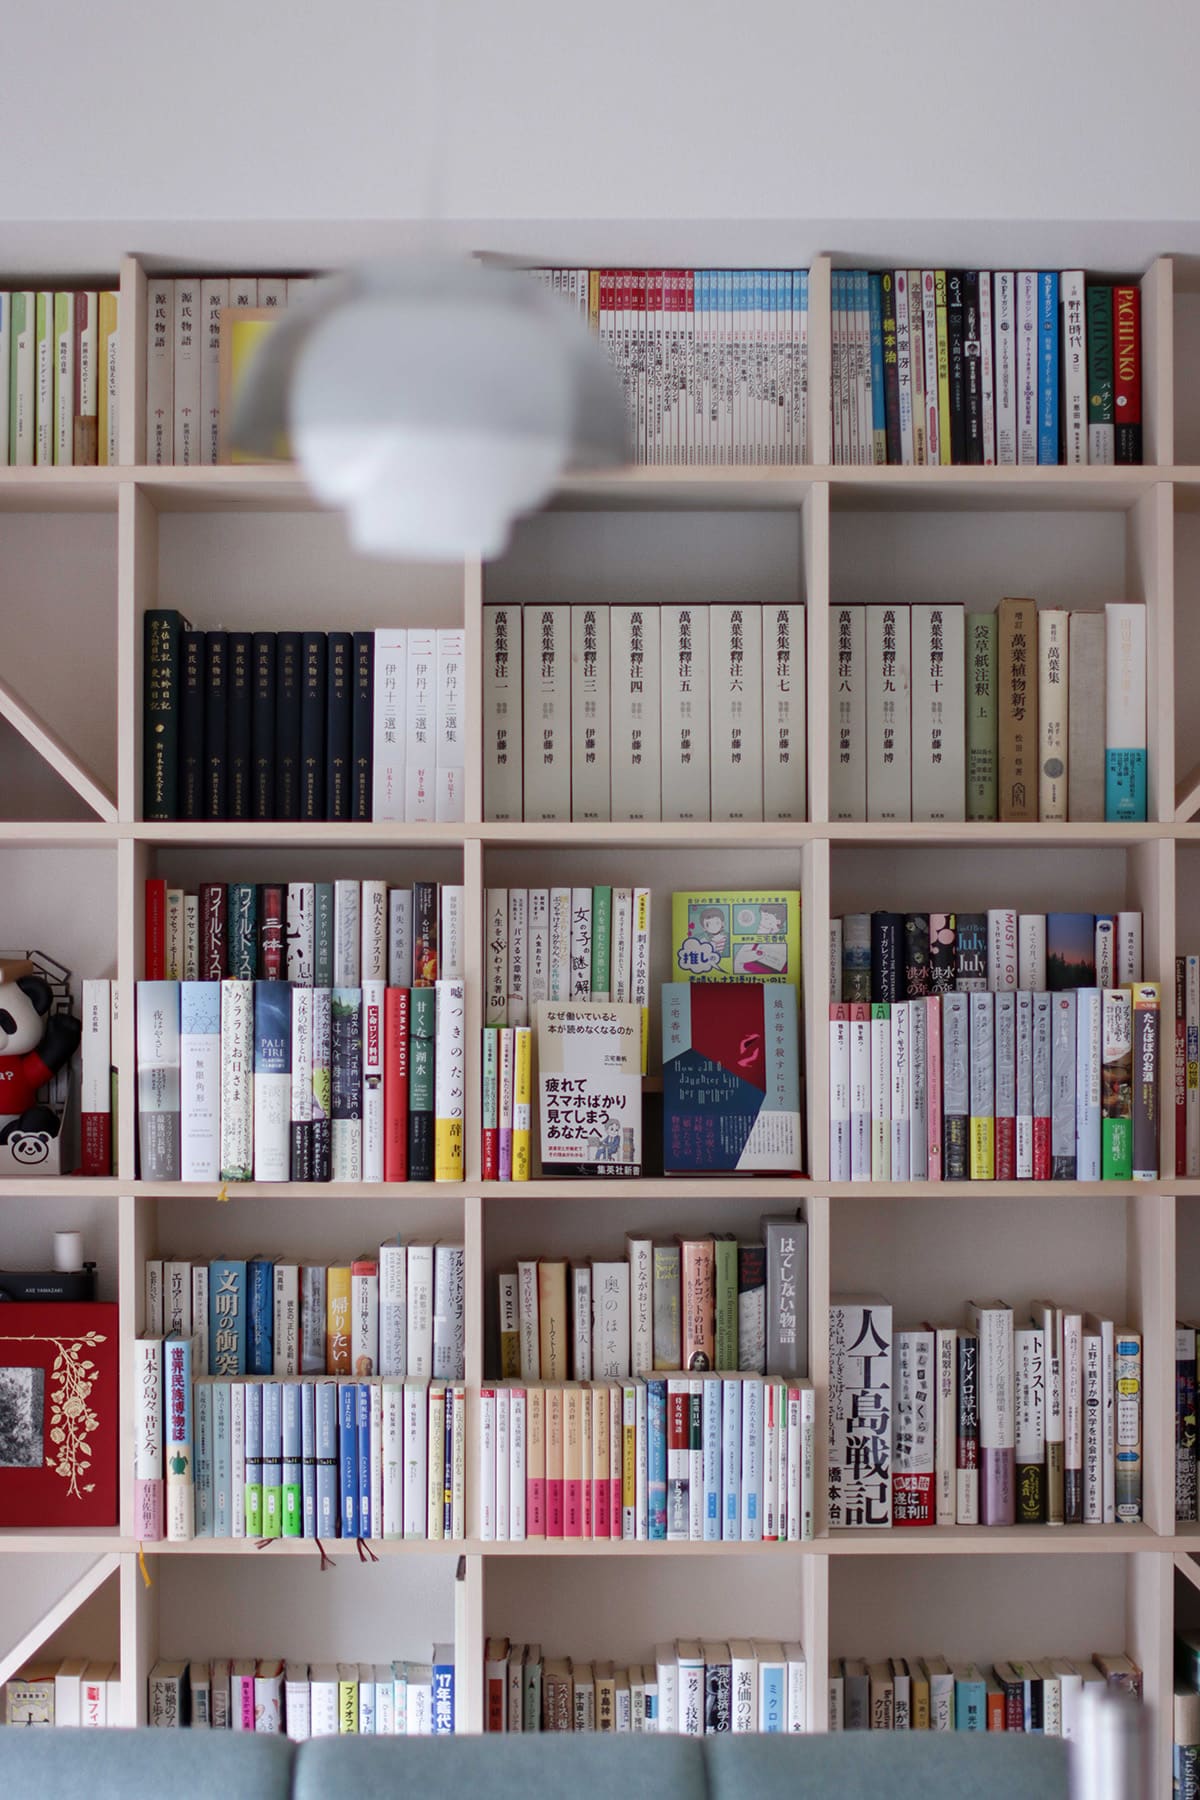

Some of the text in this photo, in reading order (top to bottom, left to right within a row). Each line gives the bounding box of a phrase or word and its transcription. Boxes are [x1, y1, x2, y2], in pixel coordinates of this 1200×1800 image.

[154, 293, 166, 348] 源氏物語
[181, 292, 192, 347] 源氏物語
[209, 296, 221, 349] 源氏物語
[884, 318, 897, 364] 橋本治
[1068, 300, 1081, 348] 野性時代
[1118, 289, 1135, 380] PACHINKO
[897, 324, 910, 387] 氷室冴子
[1101, 381, 1111, 421] パチンコ
[187, 644, 197, 687] 源氏物語
[212, 644, 221, 687] 源氏物語
[259, 644, 268, 687] 源氏物語
[309, 644, 318, 687] 源氏物語
[334, 644, 343, 687] 源氏物語
[359, 644, 368, 687] 源氏物語
[495, 611, 508, 689] 萬葉集釋注一
[542, 611, 555, 693] 萬葉集釋注二
[584, 610, 597, 693] 萬葉集釋注三
[631, 611, 643, 694] 萬葉集釋注四
[679, 610, 692, 693] 萬葉集釋注五
[730, 609, 743, 693] 萬葉集釋注六
[777, 609, 790, 693] 萬葉集釋注七
[839, 610, 852, 693] 萬葉集釋注八
[883, 610, 896, 693] 萬葉集釋注九
[930, 610, 943, 694] 萬葉集釋注十
[975, 624, 990, 719] 袋草紙注釈 上
[1010, 632, 1027, 721] 萬葉植物新考
[1047, 646, 1060, 685] 萬葉集
[385, 663, 397, 744] 伊丹十三選集
[416, 663, 428, 744] 伊丹十三選集
[445, 662, 457, 743] 伊丹十三選集
[262, 917, 284, 952] 三体
[320, 894, 329, 966] アホウドリの迷信
[373, 892, 383, 975] 偉大なるデスリフ
[395, 903, 405, 959] 消失の惑星
[489, 908, 507, 1007] 人生を狂わす名著50
[513, 927, 522, 993] バズる文章教室
[598, 900, 606, 992] それを読むたび思い出す
[1005, 914, 1014, 985] MUST GO
[1127, 930, 1135, 976] 理由のない場所
[636, 933, 646, 1005] 刺さる小説の技術
[957, 954, 985, 976] July
[91, 1004, 99, 1033] 百年の孤独
[153, 1009, 165, 1058] 夜はやさし
[231, 992, 243, 1102] クララとお日さま
[261, 1038, 286, 1050] PALE
[296, 994, 308, 1063] 文体の舵をとれ
[351, 1038, 359, 1050] IN
[369, 1006, 378, 1064] 亡命ロシア料理
[399, 994, 407, 1077] NORMAL PEOPLE
[415, 1001, 427, 1075] 甘くない湖水
[547, 1011, 617, 1023] なぜ働いていると
[547, 1025, 634, 1037] 本が読めなくなるのか
[671, 997, 681, 1045] 三宅香帆
[262, 1051, 283, 1061] FIRE
[351, 1053, 359, 1077] THE
[449, 986, 463, 1157] 嘘つきのための辞書
[774, 999, 785, 1105] 娘が母を殺すには?
[1142, 1012, 1155, 1083] たんぽぽのお酒
[195, 1059, 205, 1103] 無限角形
[545, 1078, 588, 1093] 疲れて
[547, 1094, 627, 1110] スマホばかり
[547, 1109, 611, 1125] 見てしまう
[547, 1126, 604, 1140] あなたへ
[351, 1128, 360, 1180] SAVIORS
[597, 1163, 641, 1176] 集英社新書
[455, 1249, 464, 1321] ブルシット・ジョブ
[505, 1285, 513, 1321] TO KILL
[637, 1250, 648, 1333] あしながおじさん
[694, 1256, 705, 1346] オールコットの日記
[780, 1237, 797, 1345] はてしない物語
[216, 1269, 239, 1376] 文明の衝突
[332, 1296, 349, 1361] 帰りたい
[604, 1275, 621, 1378] 奥のほそ道
[170, 1347, 186, 1442] 世界民族博物誌
[942, 1339, 953, 1399] 尾崎翠の詩学
[961, 1346, 976, 1427] マルメロ草紙
[1032, 1336, 1044, 1408] トラスト
[674, 1397, 682, 1433] 侍女の物語
[708, 1390, 718, 1450] しあわせの理由
[728, 1392, 737, 1446] ソラリス
[846, 1308, 891, 1526] 人工島戦記
[1088, 1342, 1097, 1484] 上野千鶴子が 文学を社会学する
[894, 1492, 921, 1505] 遂に
[894, 1506, 929, 1520] 復刊!!
[152, 1681, 163, 1727] 犬と歩く
[165, 1681, 176, 1728] 戦禍のア
[576, 1691, 585, 1730] 宇宙と宇
[718, 1665, 731, 1731] 現代経済学の
[737, 1671, 751, 1730] 薬価の経
[939, 1700, 947, 1730] スピノ
